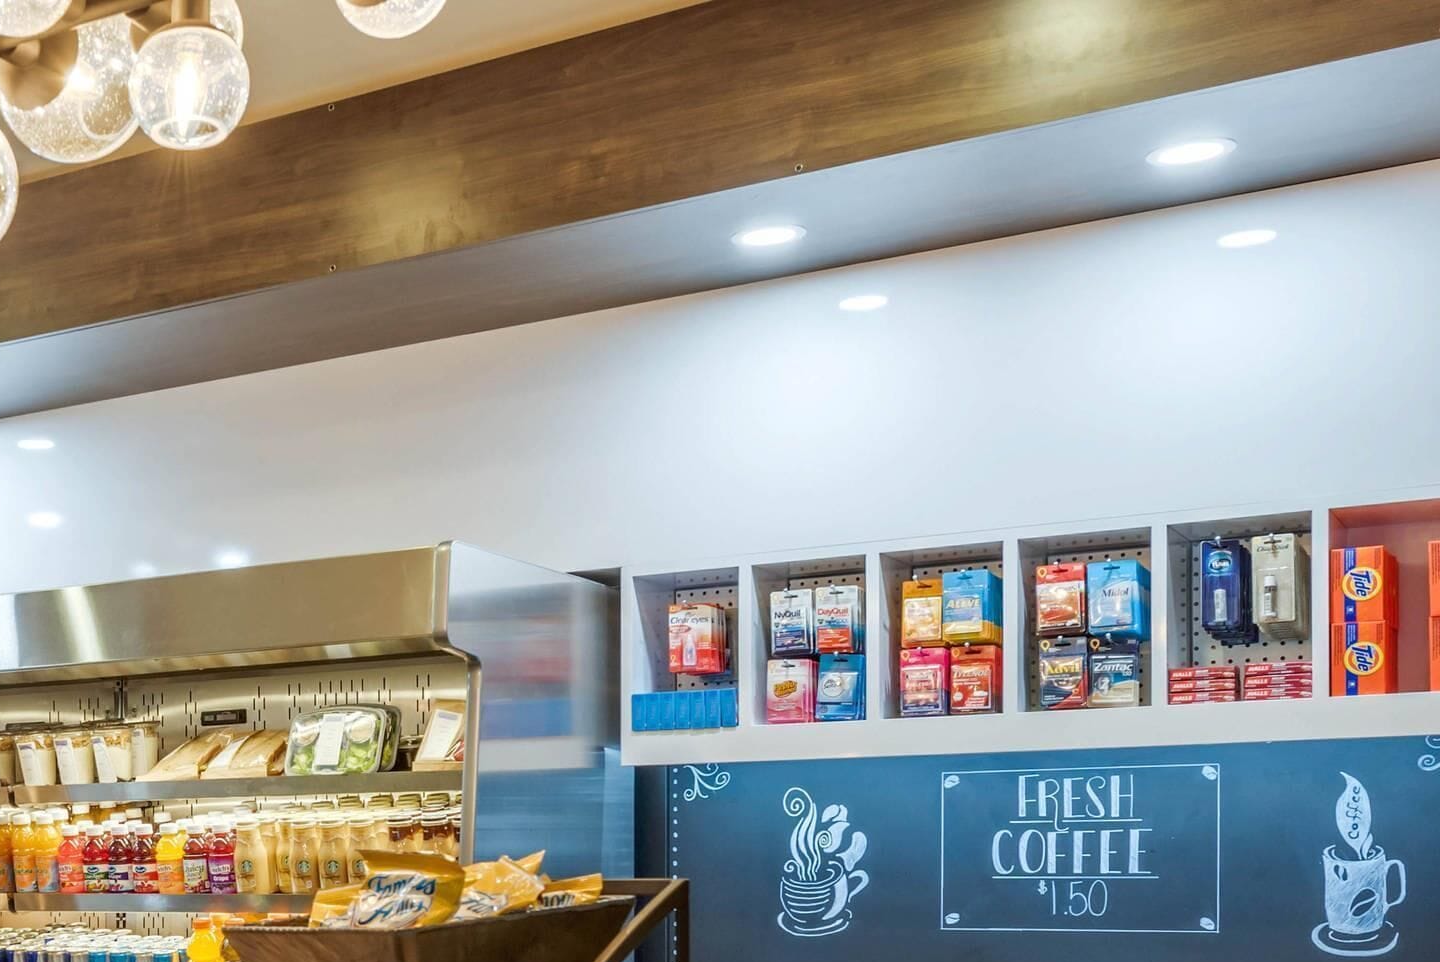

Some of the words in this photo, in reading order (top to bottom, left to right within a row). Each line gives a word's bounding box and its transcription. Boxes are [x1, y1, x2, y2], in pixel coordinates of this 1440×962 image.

[1350, 570, 1372, 597] Tide
[774, 609, 801, 619] NyQuil
[817, 607, 849, 616] DayQuil
[1094, 662, 1134, 672] Zantac
[1351, 645, 1373, 672] Tide
[1018, 774, 1134, 831] FRESH
[991, 828, 1153, 876] COFFEE
[1037, 878, 1109, 917] $1.50
